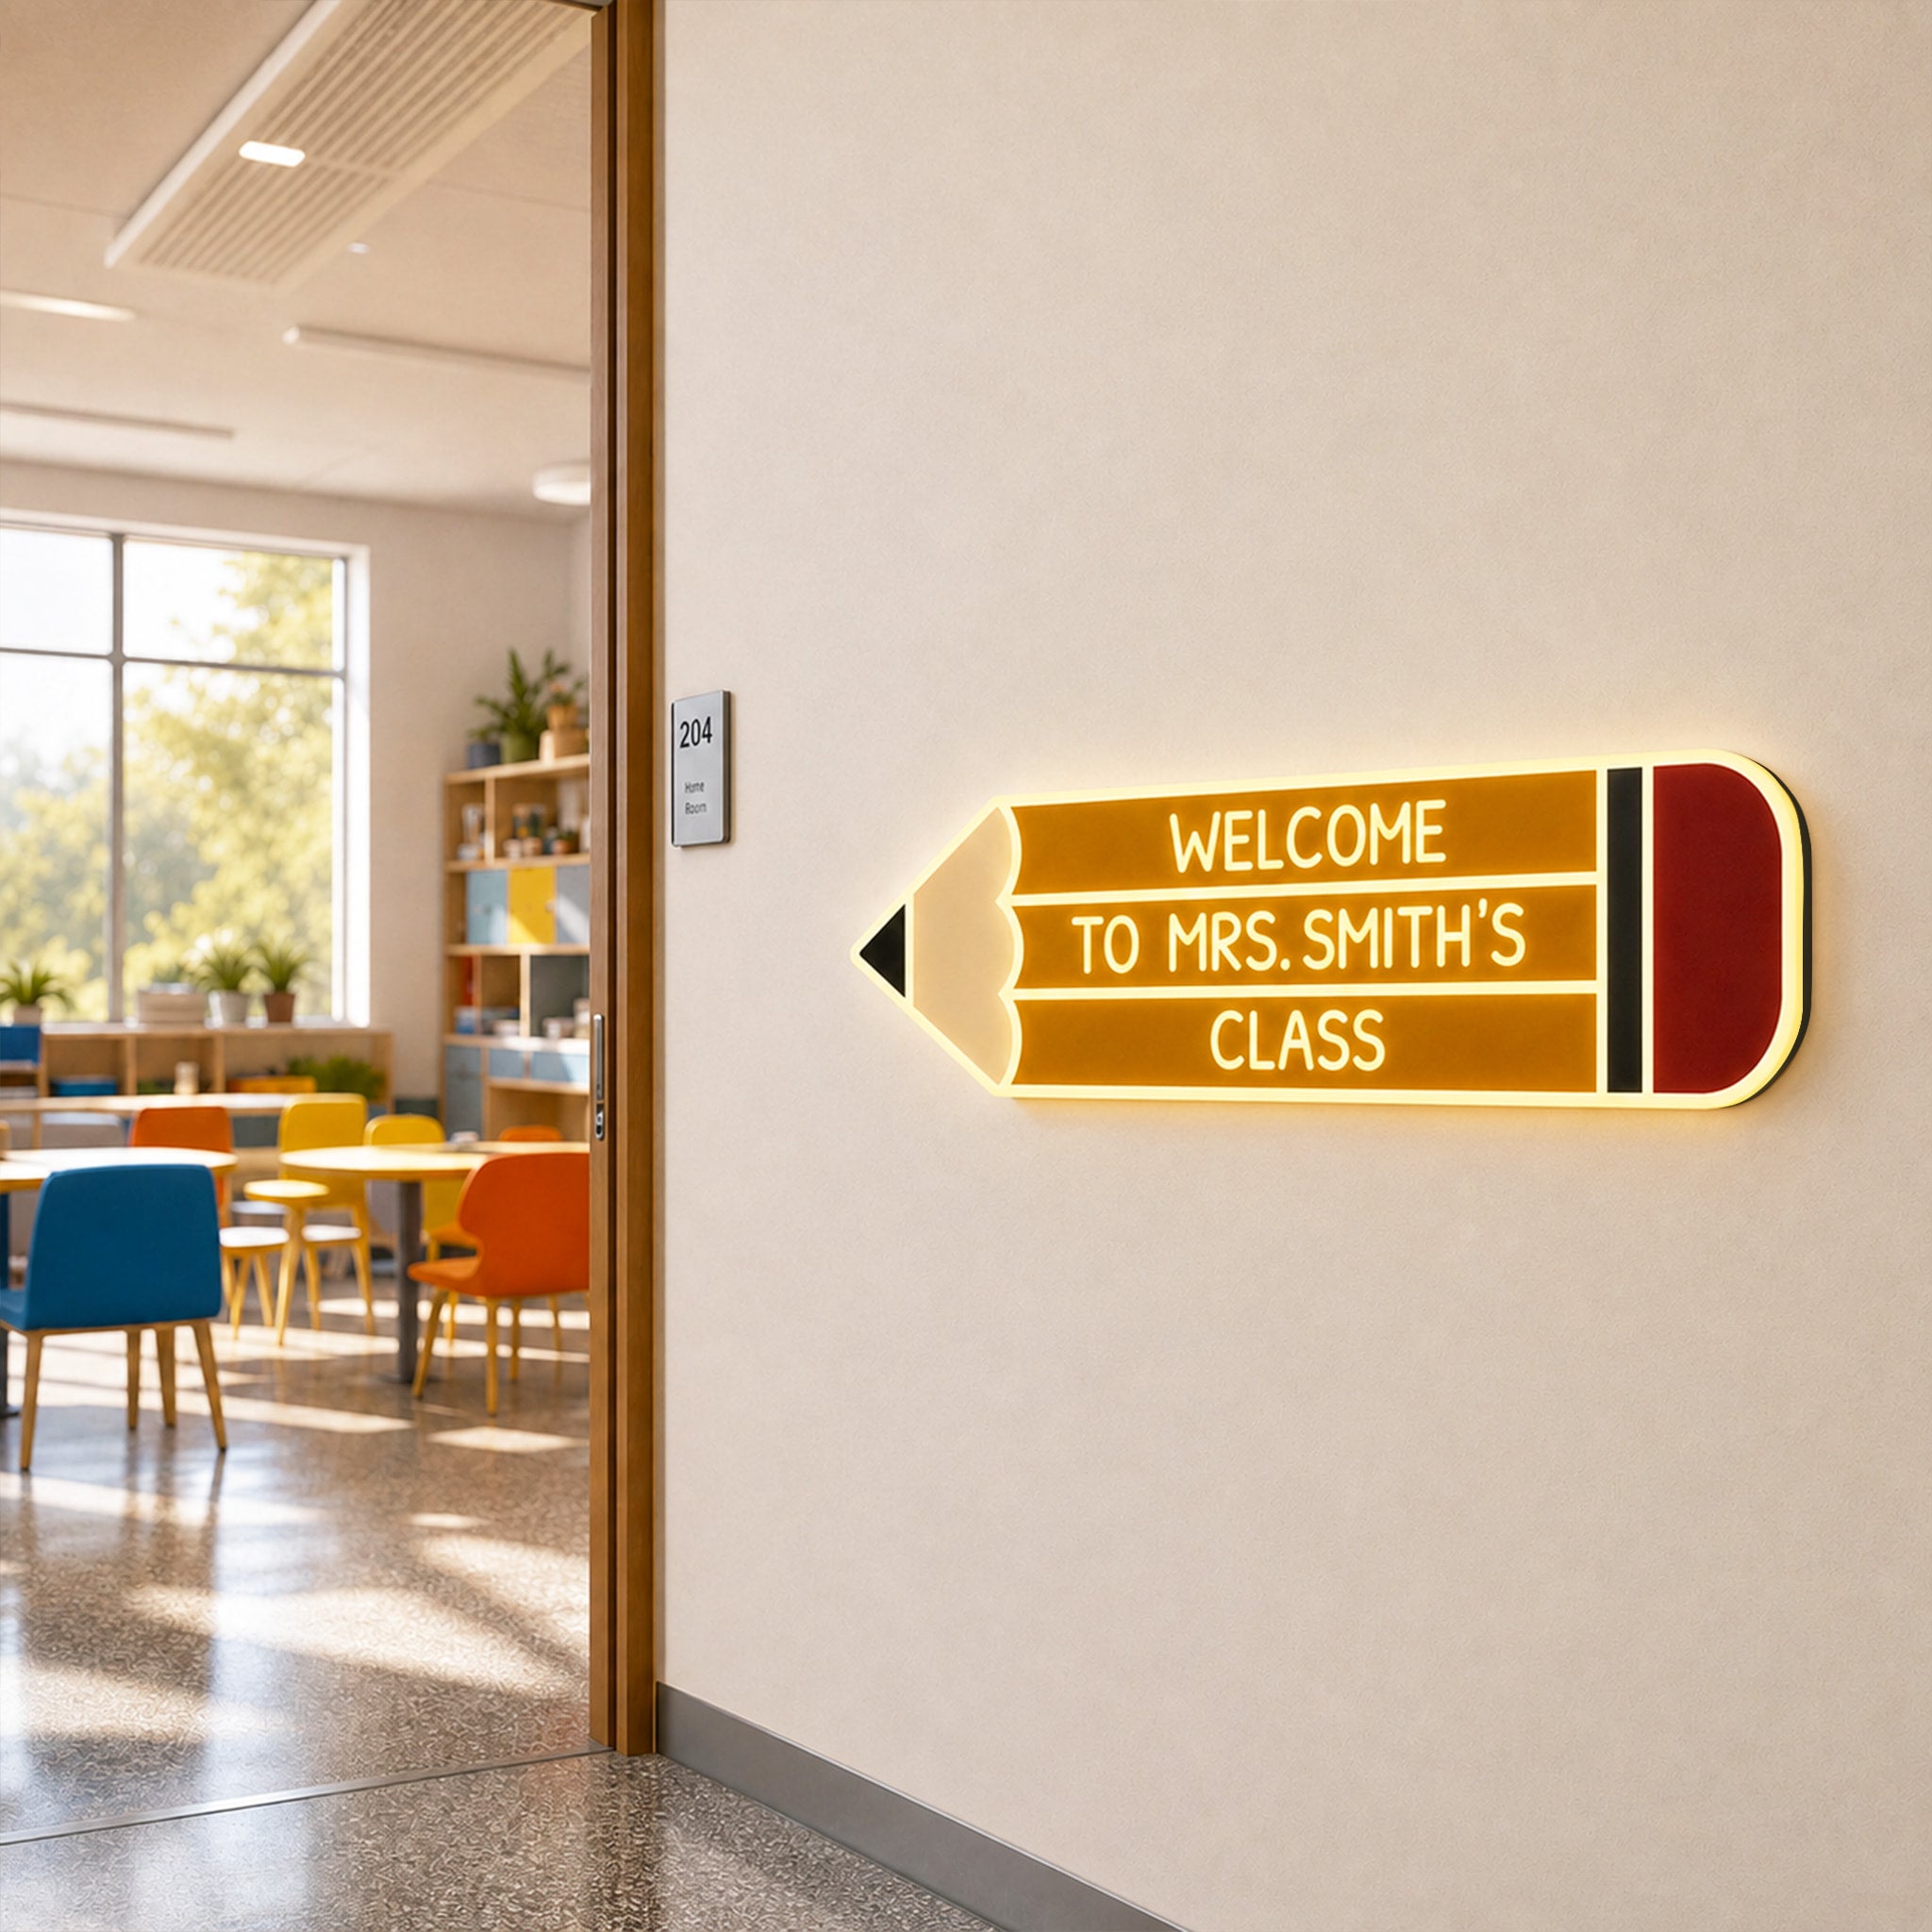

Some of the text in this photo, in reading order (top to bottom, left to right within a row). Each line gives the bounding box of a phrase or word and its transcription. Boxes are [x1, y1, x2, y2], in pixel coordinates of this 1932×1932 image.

[679, 716, 713, 749] 204
[685, 802, 707, 815] Room
[1169, 799, 1446, 874] WELCOME
[1071, 897, 1526, 975] TO MRS. SMITH'S
[1210, 1008, 1387, 1072] CLASS
